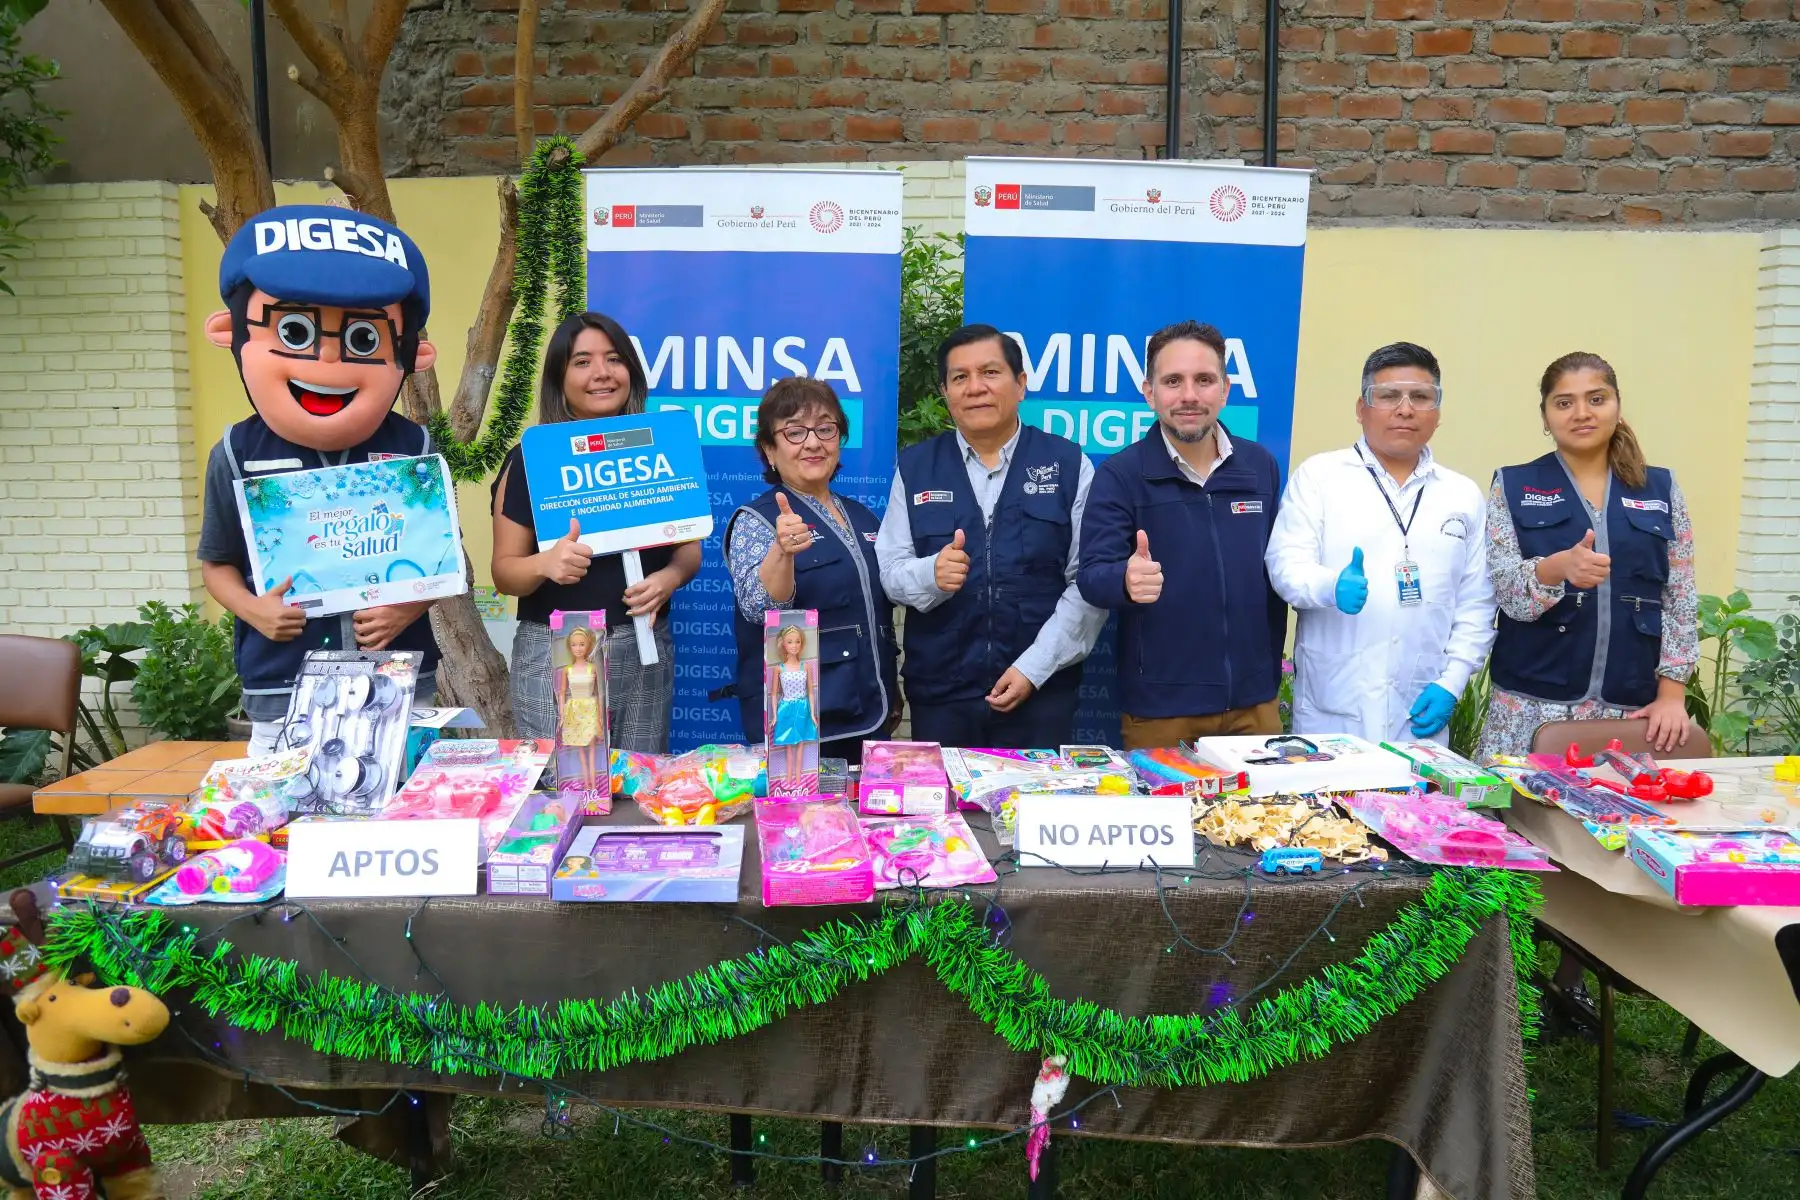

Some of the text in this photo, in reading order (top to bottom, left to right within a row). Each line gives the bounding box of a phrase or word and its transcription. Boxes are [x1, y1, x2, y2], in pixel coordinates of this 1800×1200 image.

[998, 192, 1018, 200] PERÚ
[1252, 195, 1305, 203] BICENTENARIO
[1110, 203, 1195, 215] Gobierno del Perú
[1267, 202, 1286, 210] PERÚ
[615, 212, 633, 220] PERÚ
[717, 219, 796, 229] Gobierno del Perú
[254, 218, 409, 270] DIGESA
[1003, 332, 1258, 398] MINA
[1043, 408, 1156, 447] DIGE
[560, 453, 675, 492] DIGESA
[583, 494, 617, 505] GENERAL
[619, 491, 629, 499] DE
[631, 488, 655, 498] SALUD
[656, 482, 699, 494] AMBIENTAL
[1525, 493, 1561, 502] DIGESA
[571, 495, 674, 516] E INOCUIDAD ALIMENTARIA
[309, 508, 353, 521] El mejor
[323, 512, 390, 541] regalo
[314, 539, 341, 549] es tu
[342, 533, 398, 559] salud
[676, 578, 733, 593] IGESA
[692, 602, 718, 612] Salud
[672, 621, 732, 636] DIGESA
[692, 645, 718, 655] Salud
[673, 664, 732, 680] DIGESA
[672, 707, 732, 722] DIGESA
[691, 730, 717, 740] Salud
[1039, 824, 1175, 846] NO APTOS
[328, 848, 440, 879] APTOS
